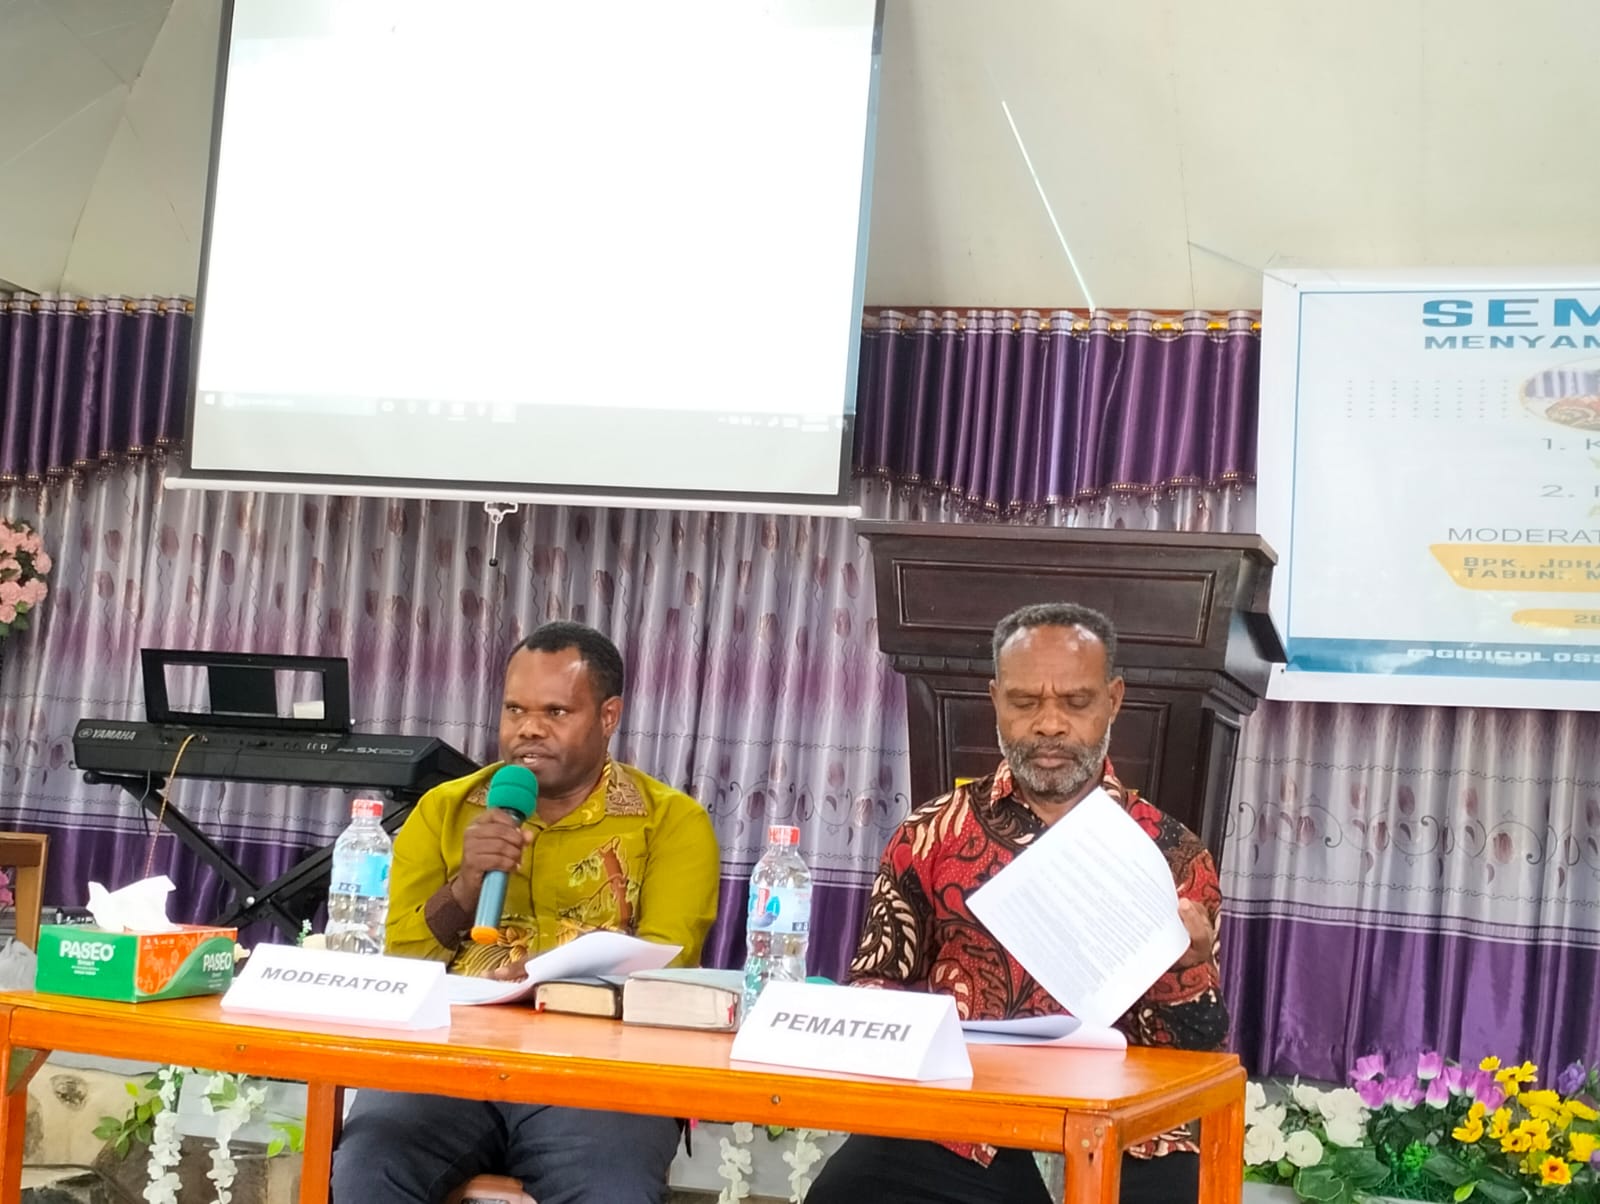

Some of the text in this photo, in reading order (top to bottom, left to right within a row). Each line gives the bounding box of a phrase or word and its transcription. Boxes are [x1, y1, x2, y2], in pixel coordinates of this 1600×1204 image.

[1422, 297, 1600, 327] SEM
[92, 729, 137, 740] YAMAHA
[59, 940, 114, 962] PASEO
[203, 952, 232, 972] PASEO
[260, 967, 409, 994] MODERATOR
[770, 1011, 912, 1042] PEMATERI
